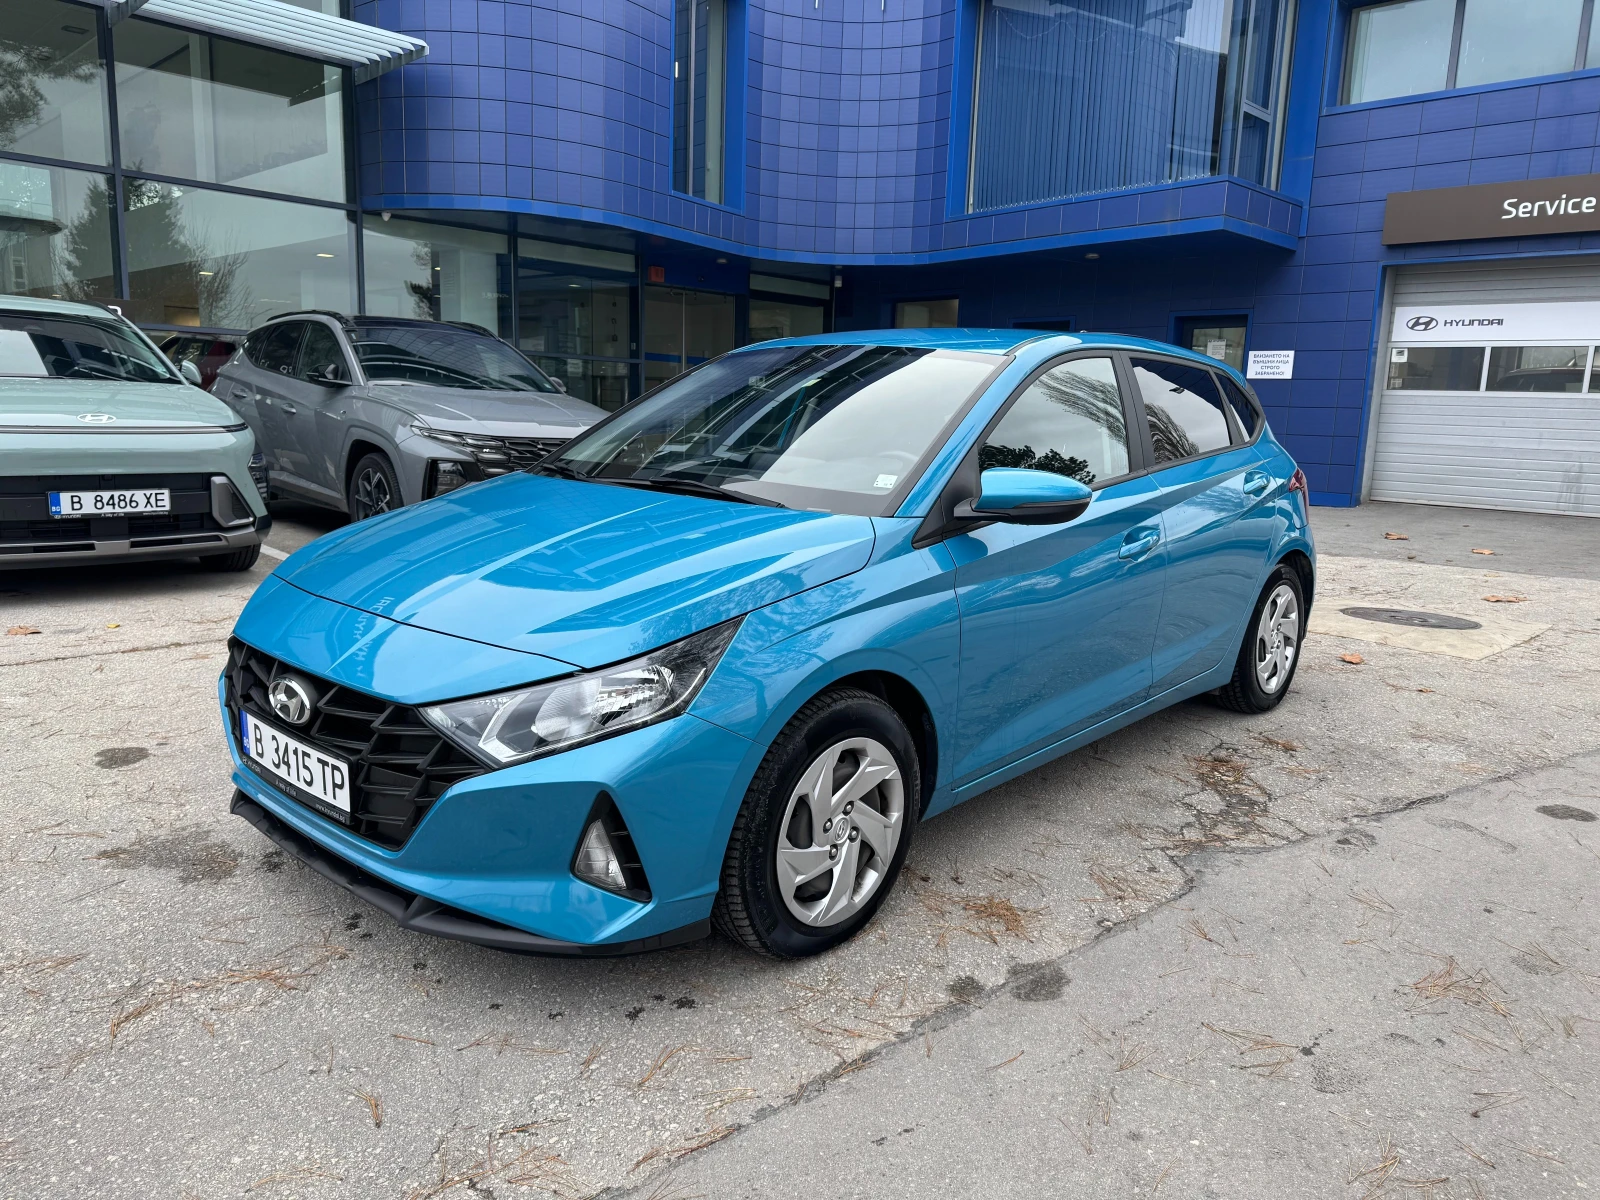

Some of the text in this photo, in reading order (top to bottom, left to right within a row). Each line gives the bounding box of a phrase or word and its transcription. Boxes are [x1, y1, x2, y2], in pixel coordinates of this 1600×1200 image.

[1501, 194, 1597, 219] Service
[1443, 318, 1504, 327] HYUNDAI
[71, 492, 167, 511] B 8486 XE
[253, 722, 345, 801] B 3415 TP
